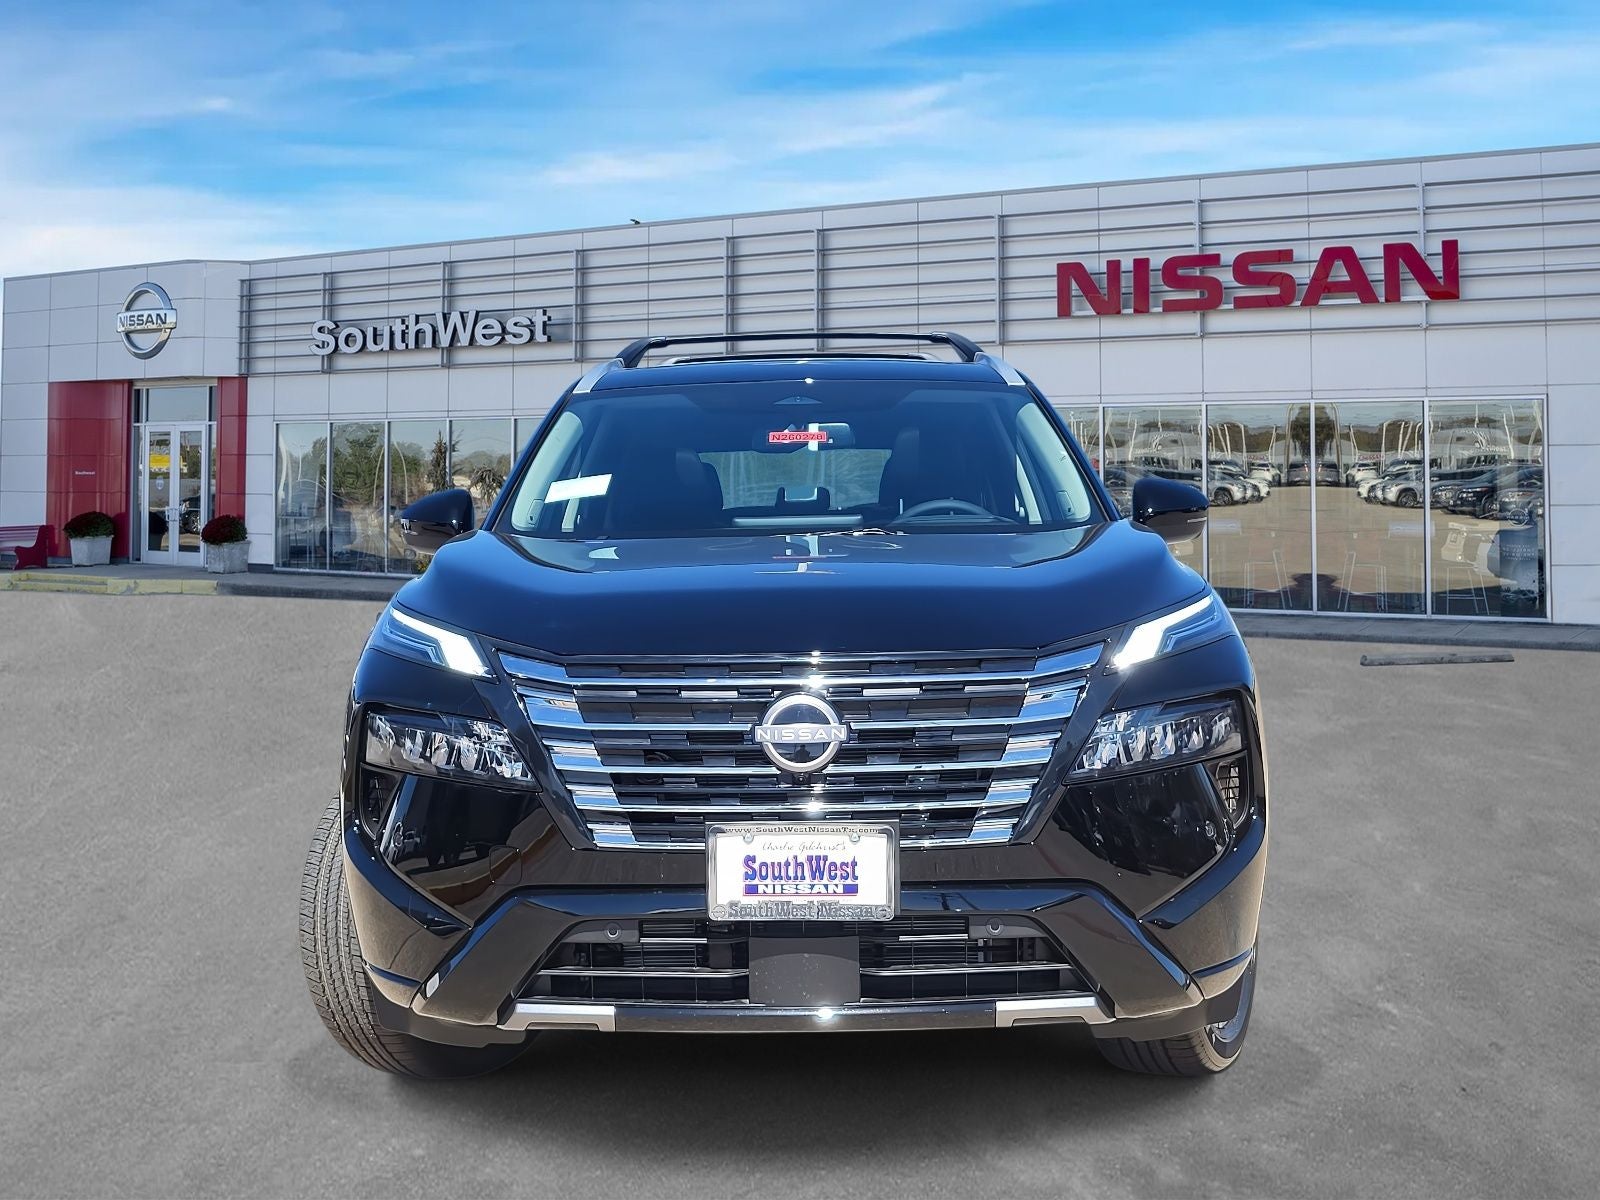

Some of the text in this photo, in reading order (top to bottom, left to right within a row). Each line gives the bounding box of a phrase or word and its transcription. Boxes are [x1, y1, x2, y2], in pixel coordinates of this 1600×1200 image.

[1057, 239, 1460, 317] NISSAN
[119, 313, 167, 327] NISSAN
[310, 309, 551, 356] SouthWest
[757, 728, 845, 741] NISSAN
[743, 855, 859, 882] SouthWest
[758, 884, 843, 894] NISSAN
[727, 902, 815, 917] SouthWest
